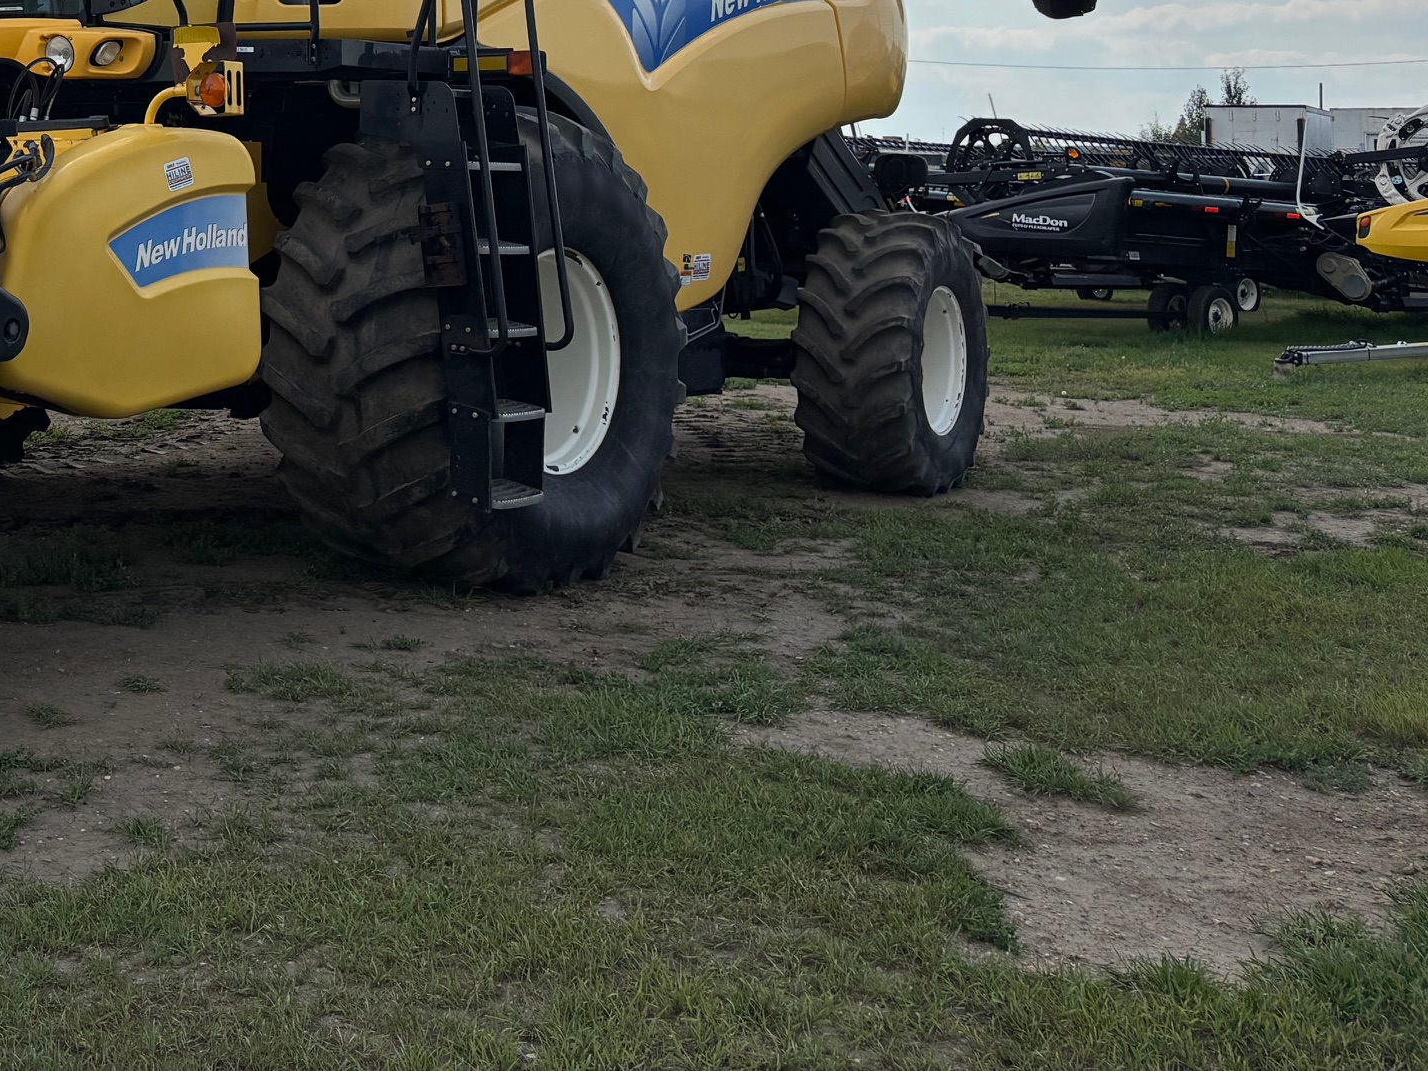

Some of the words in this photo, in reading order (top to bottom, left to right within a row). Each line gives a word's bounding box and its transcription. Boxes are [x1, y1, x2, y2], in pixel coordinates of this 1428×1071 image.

[1012, 213, 1068, 227] MacDon
[134, 239, 181, 273] New
[182, 223, 248, 255] Holland
